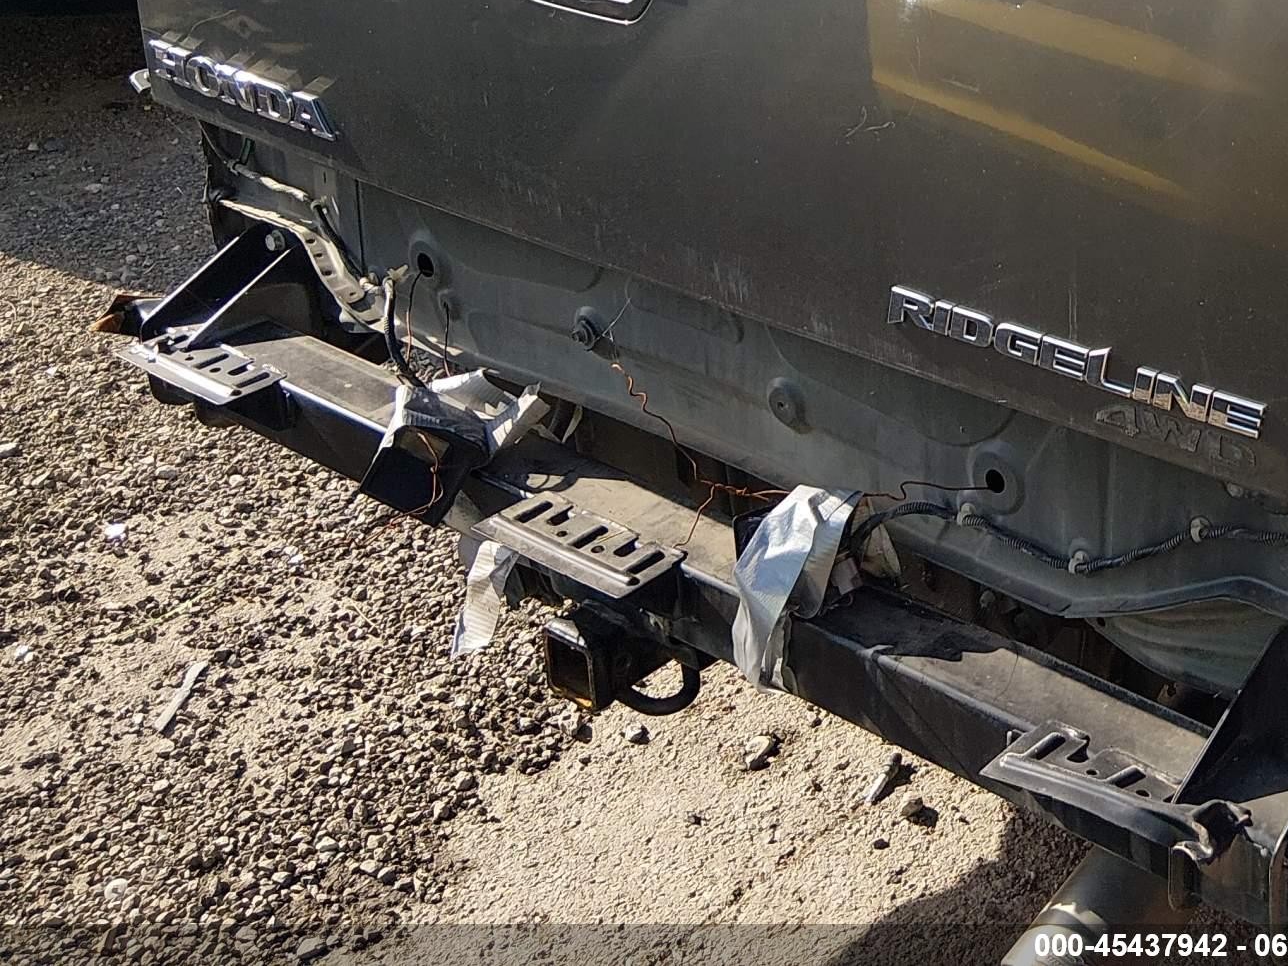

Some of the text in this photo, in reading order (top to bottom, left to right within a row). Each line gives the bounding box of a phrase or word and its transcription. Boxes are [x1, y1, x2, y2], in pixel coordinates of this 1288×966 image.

[149, 39, 337, 141] HONDA
[887, 284, 1268, 439] RIDGELINE
[1095, 404, 1257, 467] 4WD
